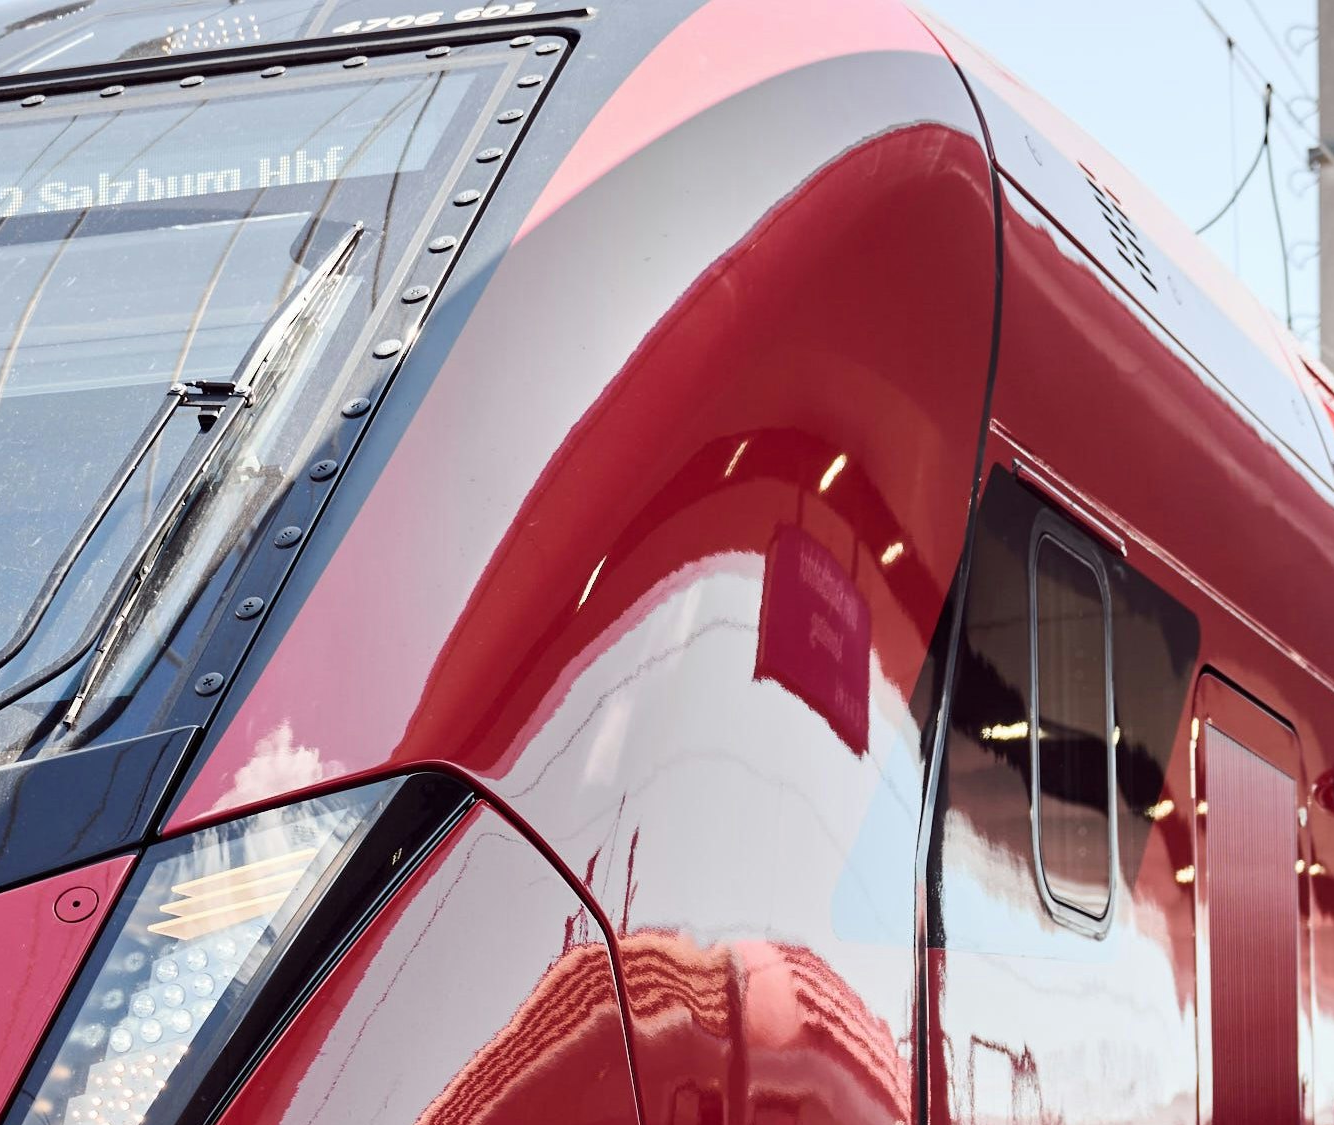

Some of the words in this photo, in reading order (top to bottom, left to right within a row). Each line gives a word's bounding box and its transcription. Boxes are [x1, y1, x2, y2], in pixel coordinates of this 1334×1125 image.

[332, 12, 443, 34] 4706
[454, 1, 537, 22] 603
[260, 146, 344, 188] Hbf
